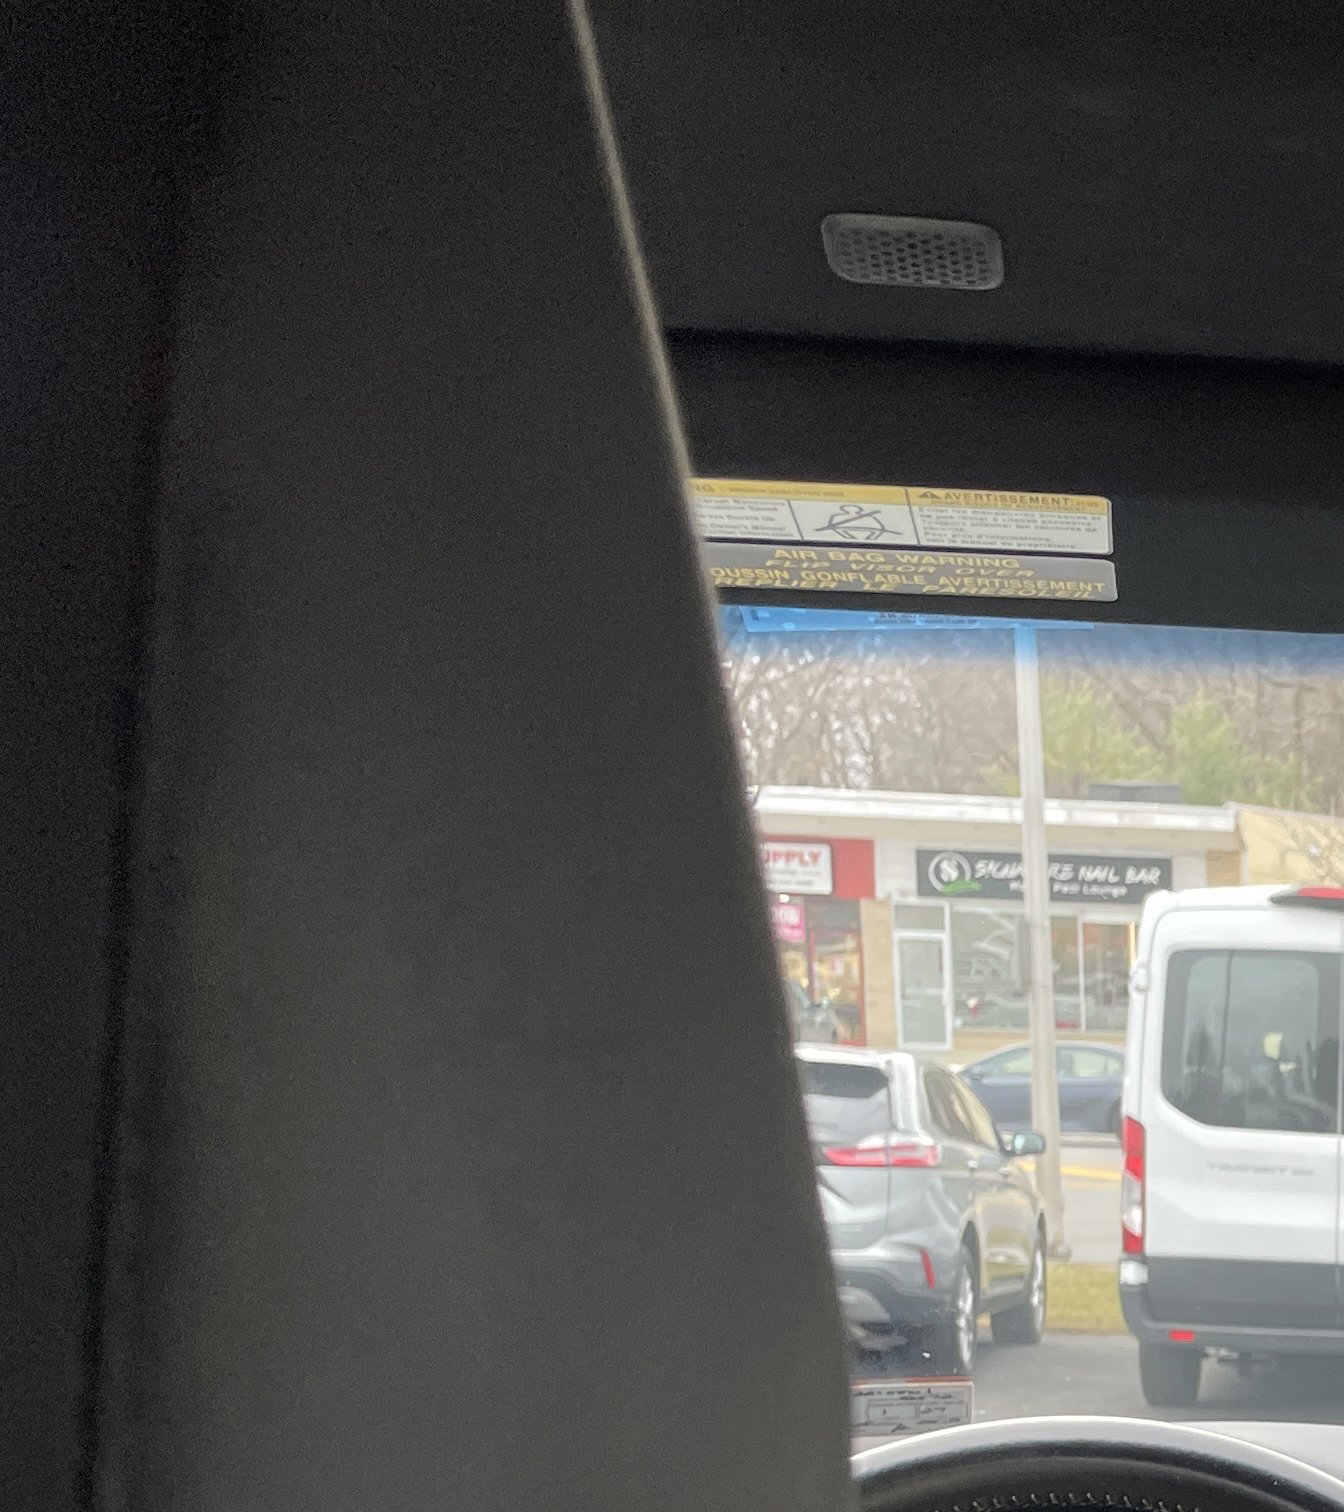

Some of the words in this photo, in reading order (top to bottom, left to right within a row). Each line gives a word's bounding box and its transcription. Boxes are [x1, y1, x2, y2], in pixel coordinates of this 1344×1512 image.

[944, 491, 1070, 507] AVERTISSEMENT
[765, 559, 831, 569] FLIP
[850, 563, 936, 574] VISOR
[955, 568, 1035, 578] OVER
[774, 549, 817, 561] AIR
[828, 551, 885, 563] BAG
[895, 554, 1020, 569] WARNING
[710, 567, 789, 580] OUSSIN
[801, 569, 927, 586] GONFLABLE
[938, 576, 1106, 594] AVERTISSEMENT
[763, 849, 822, 867] UPPLY
[974, 859, 1075, 881] SIGNARE
[1078, 864, 1121, 884] NAIL
[1124, 866, 1162, 885] BAR
